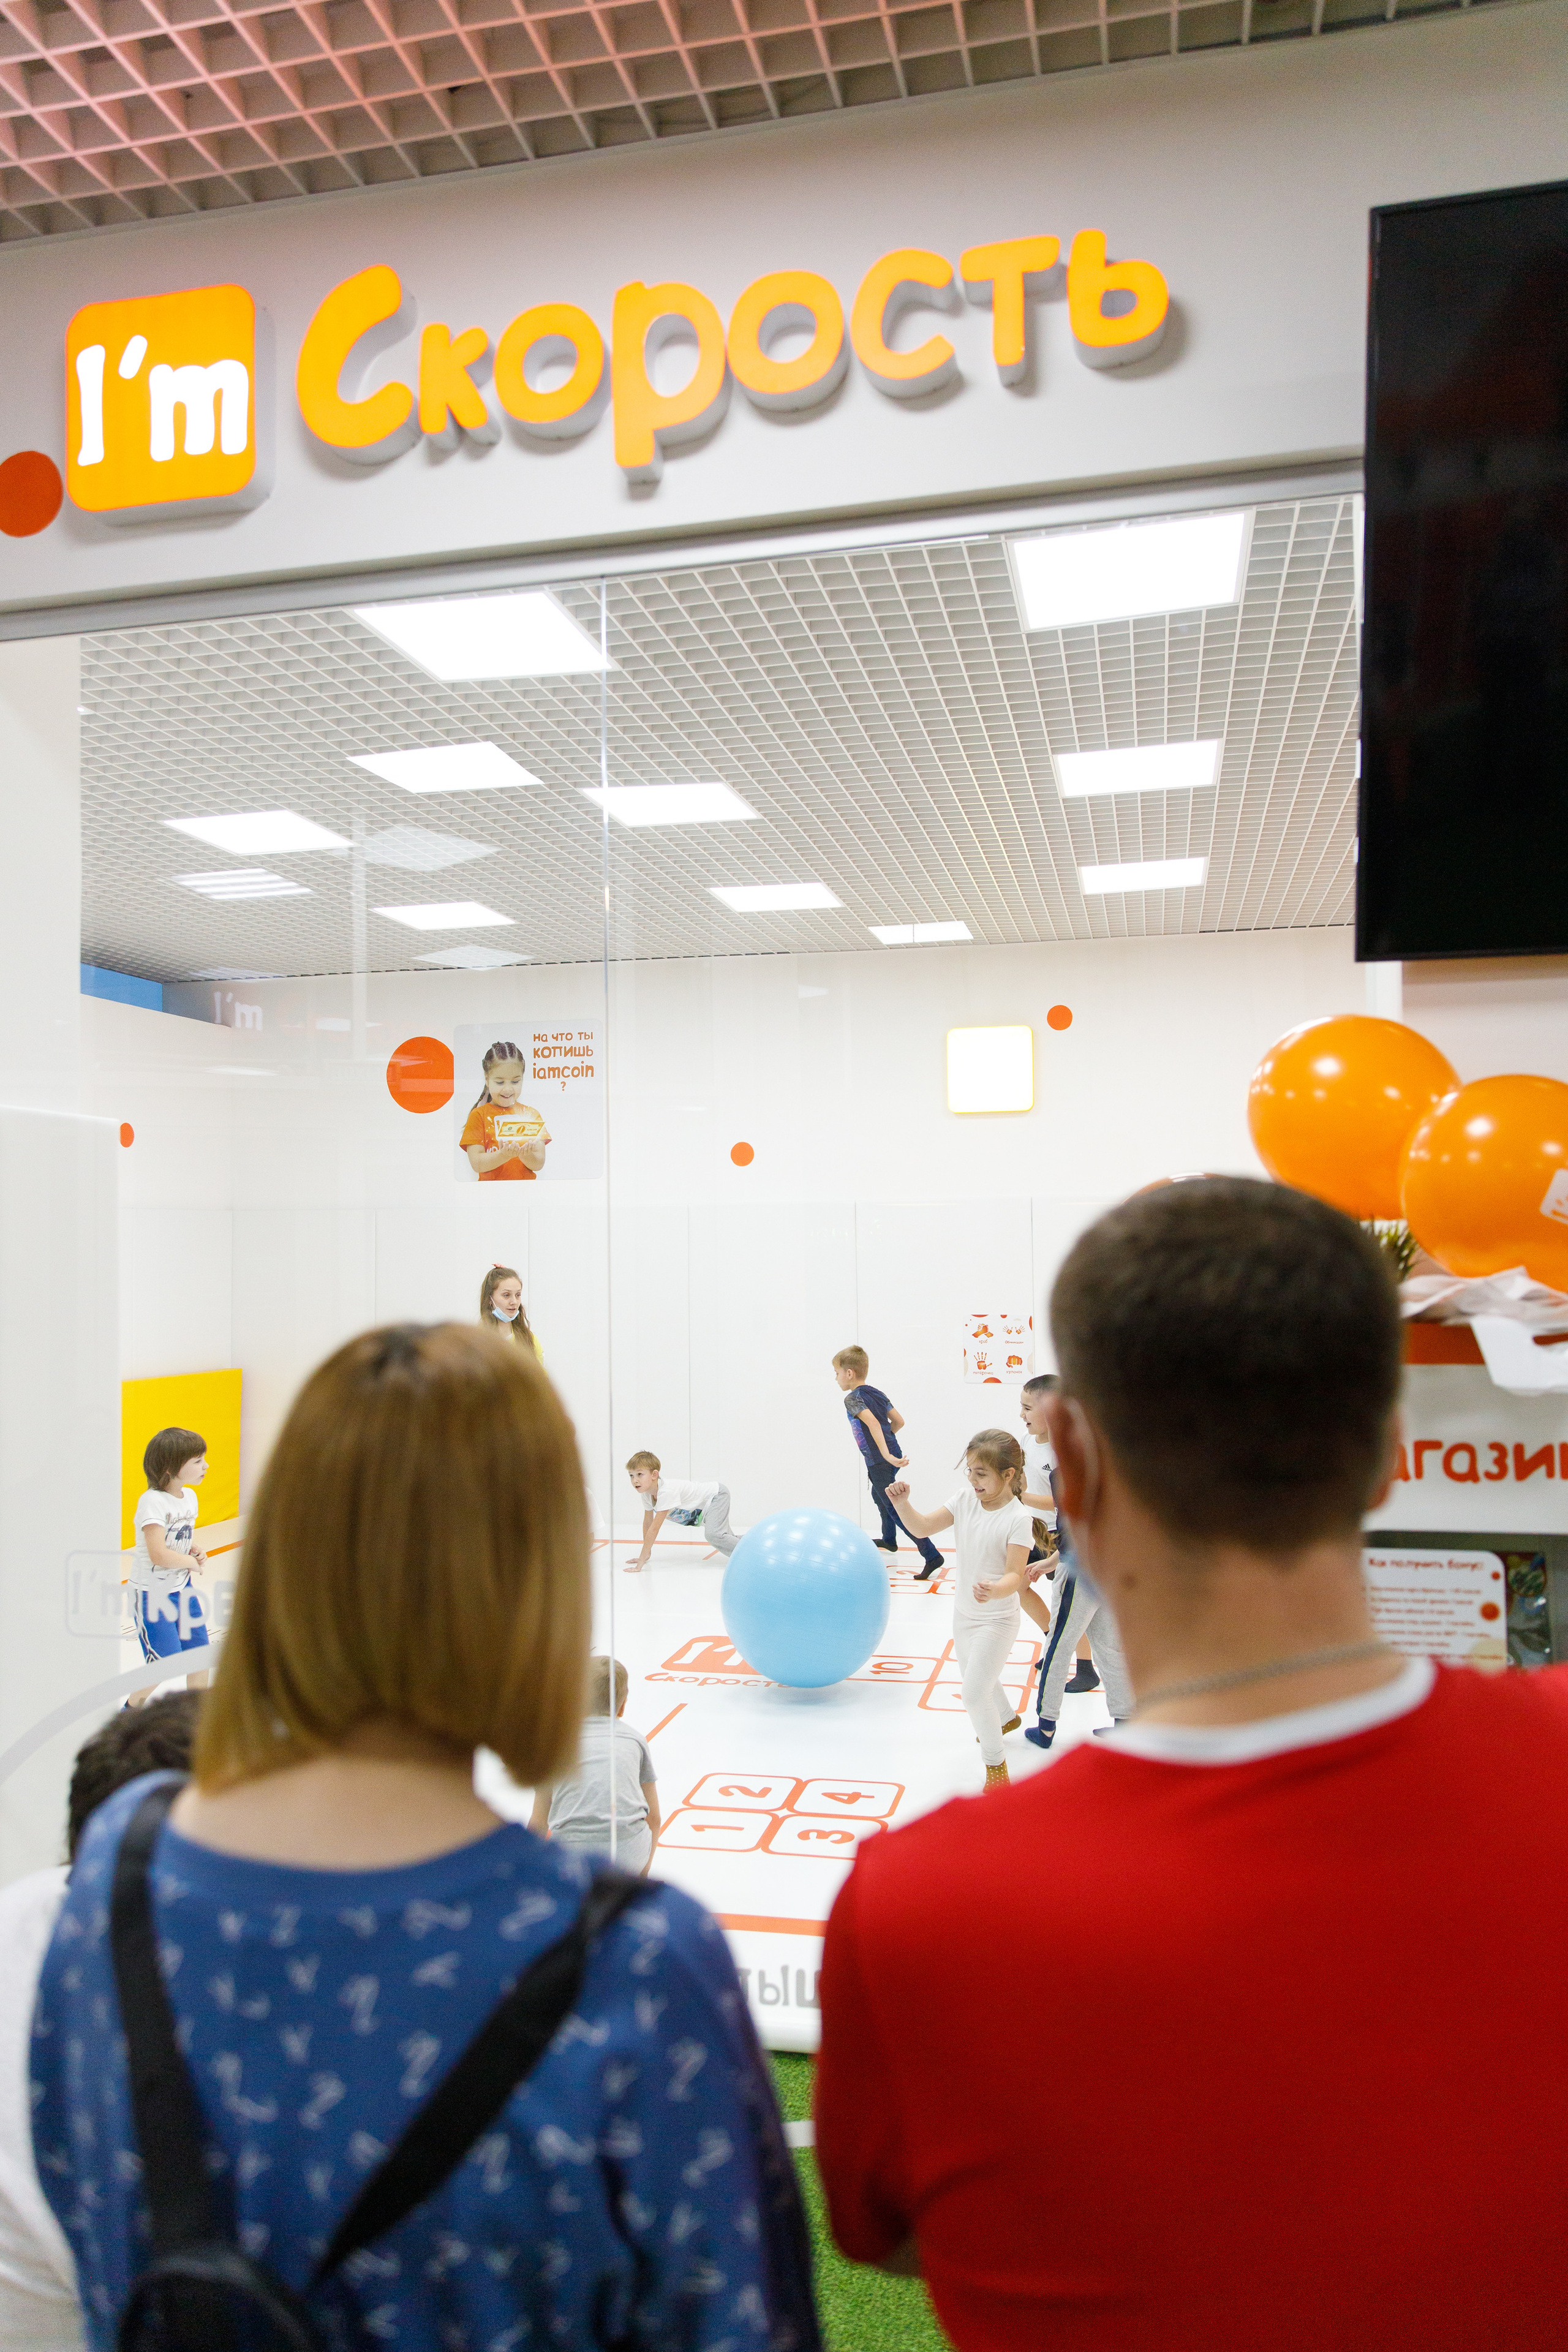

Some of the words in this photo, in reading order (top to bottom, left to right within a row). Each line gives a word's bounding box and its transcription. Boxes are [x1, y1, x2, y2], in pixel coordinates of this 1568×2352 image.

[76, 334, 249, 466] I'm
[296, 228, 1169, 467] Скорость
[533, 1033, 548, 1042] на
[551, 1032, 573, 1042] что
[578, 1031, 594, 1041] ты
[533, 1045, 594, 1059] копишь
[533, 1060, 594, 1080] iamcoin
[560, 1081, 567, 1091] ?
[1398, 1440, 1568, 1482] гази
[718, 1785, 772, 1798] 2
[821, 1792, 875, 1805] 4
[797, 1829, 855, 1844] 3
